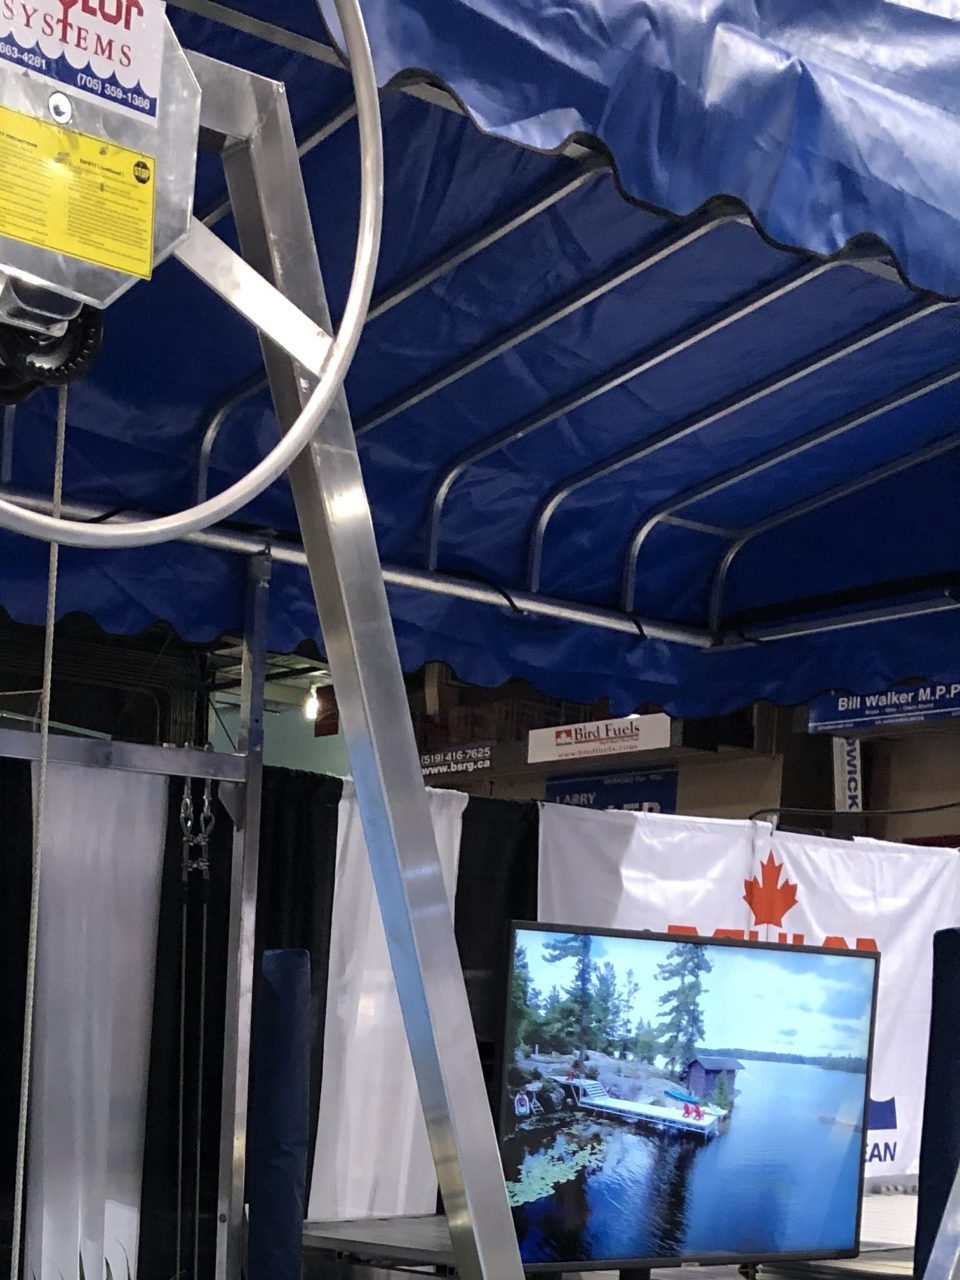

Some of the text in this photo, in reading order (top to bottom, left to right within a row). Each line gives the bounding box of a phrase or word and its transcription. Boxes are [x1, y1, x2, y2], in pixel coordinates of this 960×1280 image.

[2, 0, 132, 67] SYSTEMS
[0, 42, 46, 70] 663-4281
[77, 72, 102, 95] (705)
[133, 165, 151, 179] STOP
[838, 696, 861, 712] Bill
[865, 691, 916, 708] Walker
[574, 720, 640, 741] Bird Fuels
[445, 746, 492, 761] 416-7625
